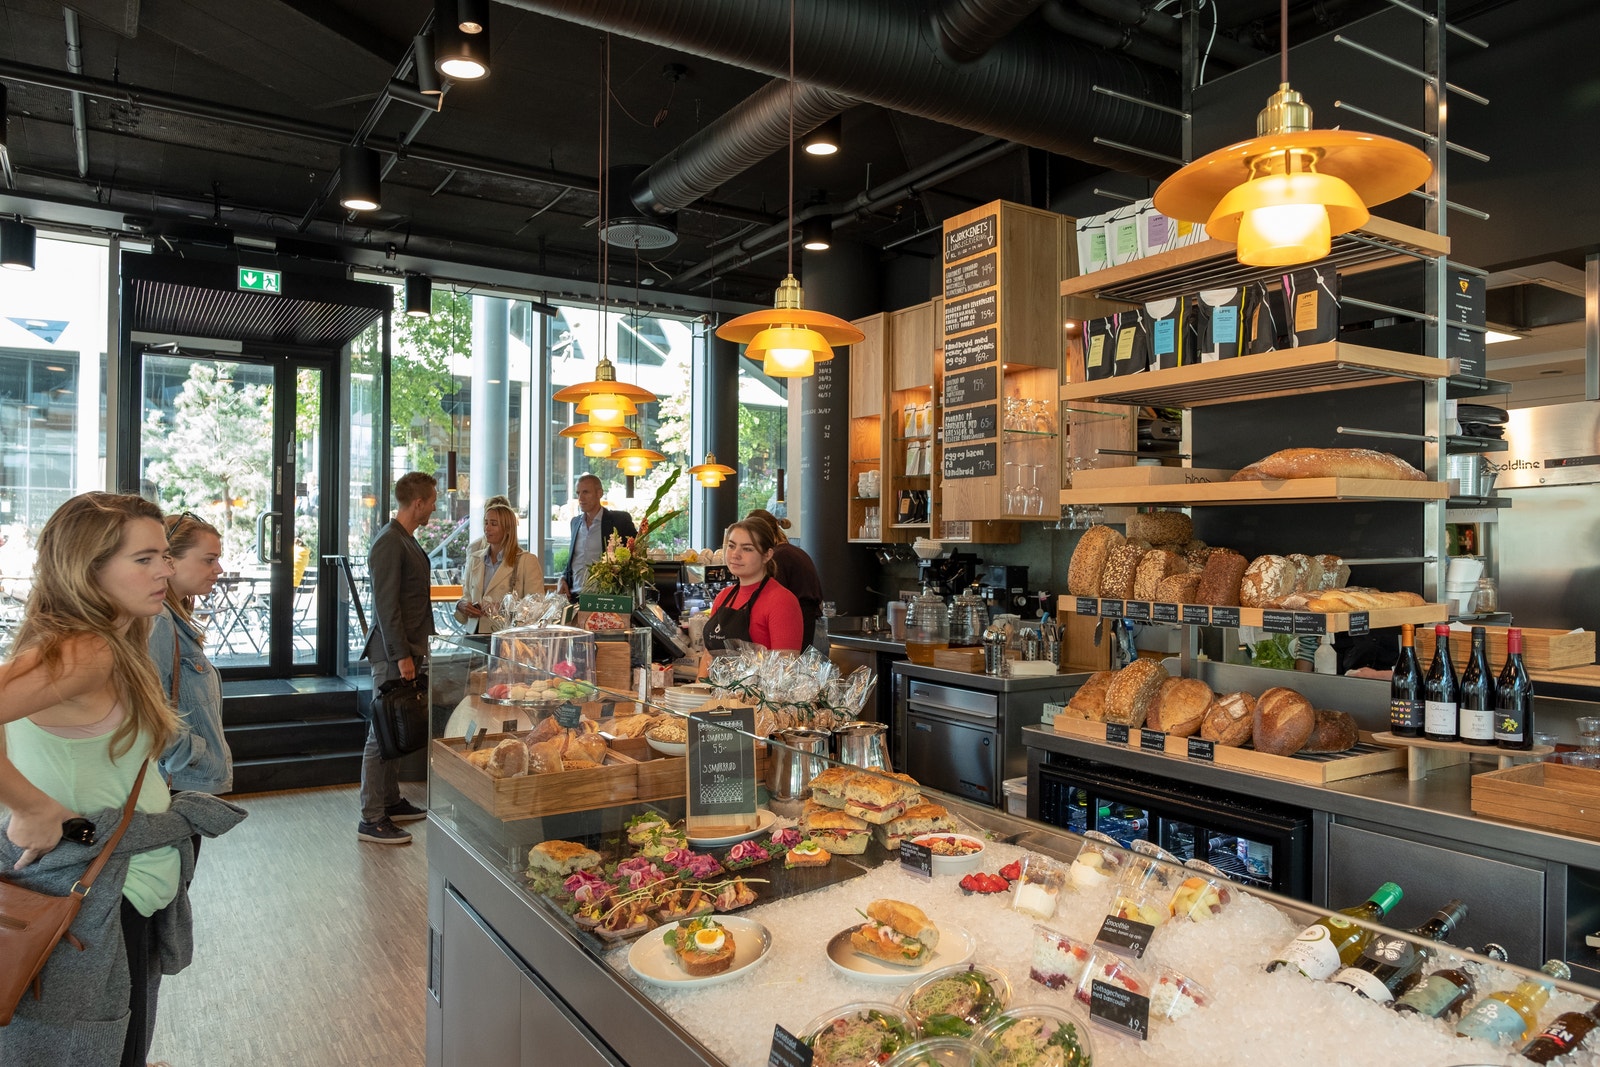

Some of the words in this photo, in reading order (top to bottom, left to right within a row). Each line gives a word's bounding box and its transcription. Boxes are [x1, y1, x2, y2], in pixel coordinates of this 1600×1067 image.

[950, 221, 988, 245] KJØKKENETS
[587, 602, 624, 610] PIZZA
[1105, 918, 1130, 931] Smoothie
[1092, 991, 1103, 1000] med
[1093, 983, 1131, 1003] Cottagecheese
